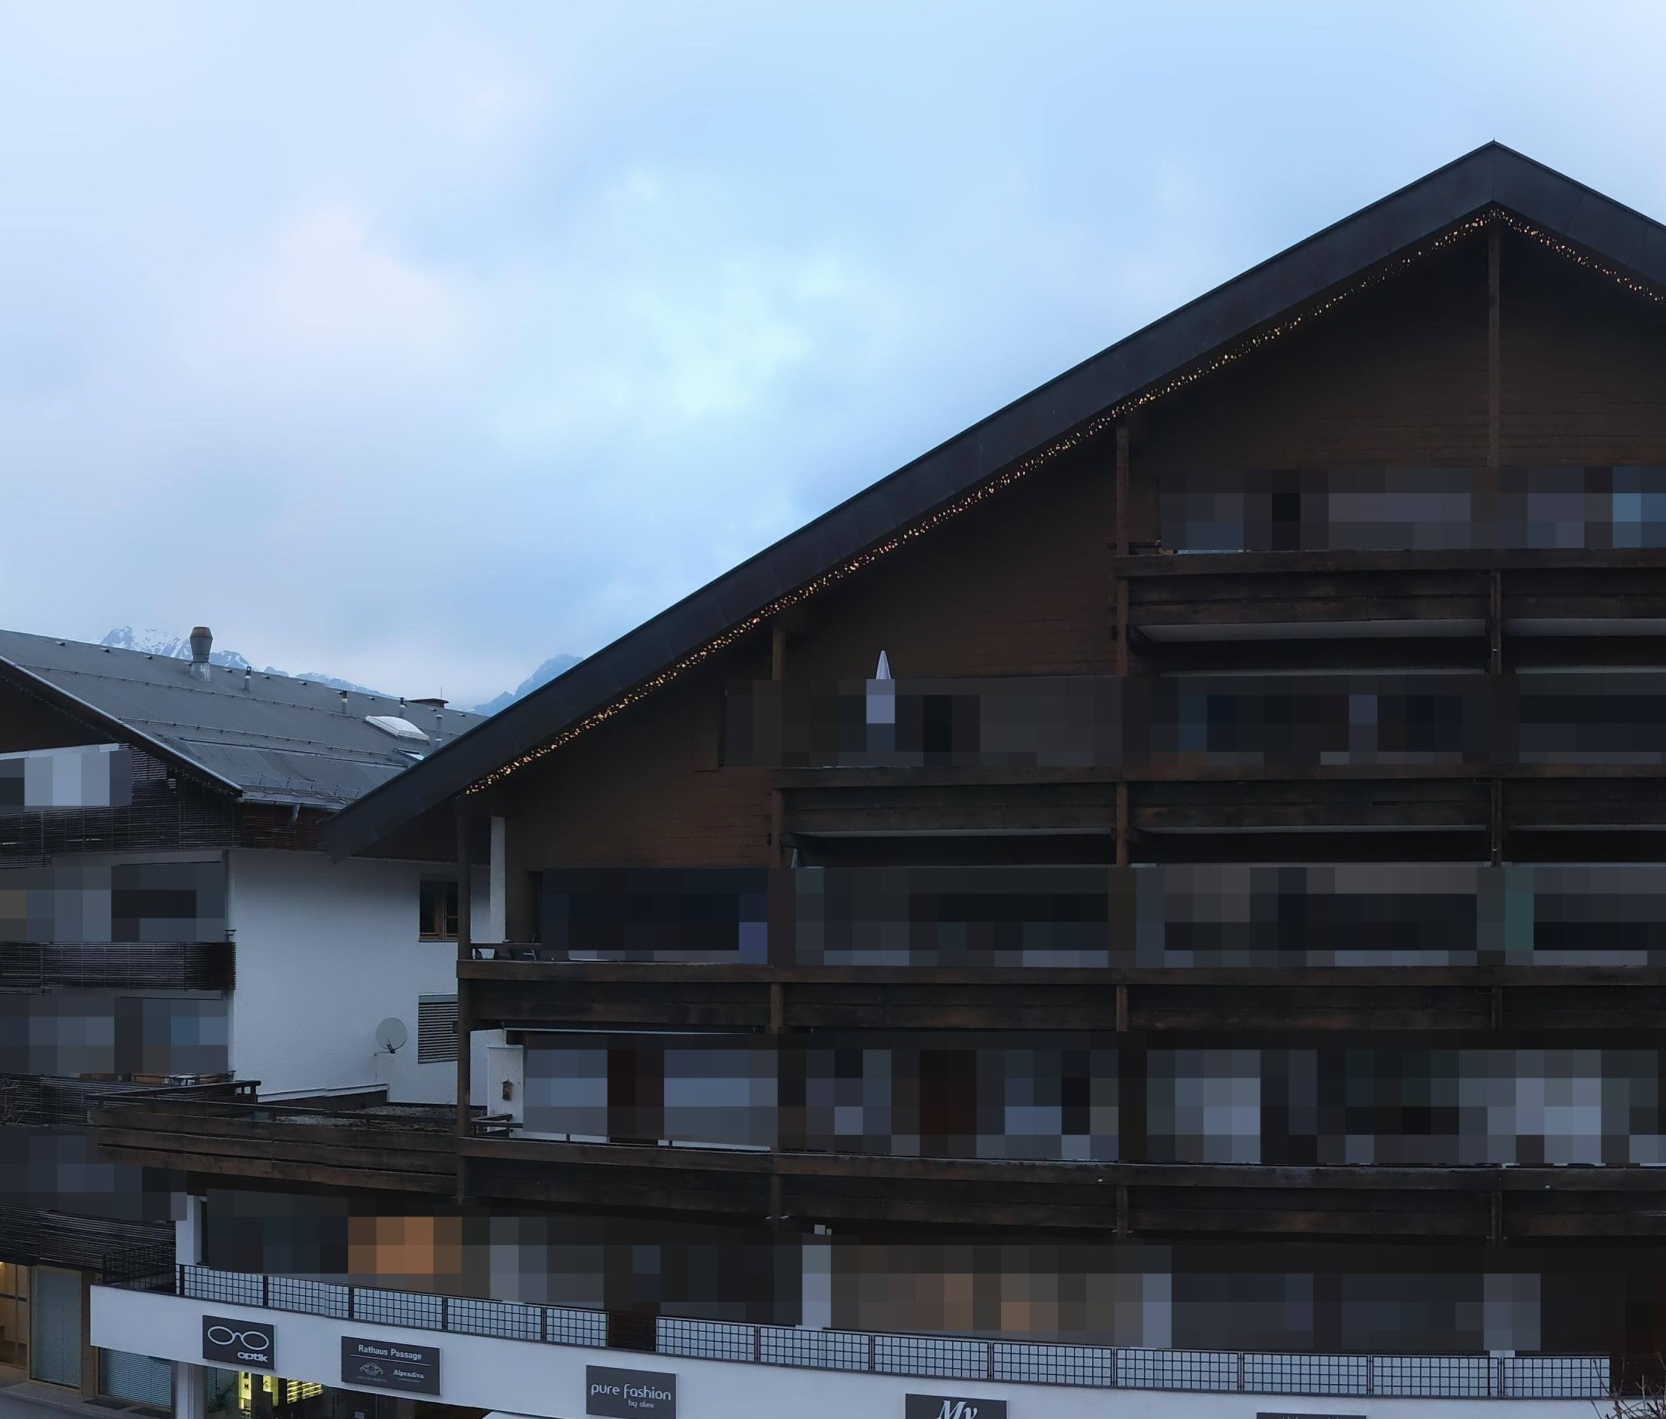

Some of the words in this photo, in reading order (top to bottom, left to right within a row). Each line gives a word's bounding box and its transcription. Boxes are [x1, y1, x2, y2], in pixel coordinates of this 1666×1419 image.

[237, 1351, 269, 1363] optik
[358, 1344, 389, 1358] Rathaus
[390, 1348, 422, 1361] Passage
[591, 1384, 620, 1396] pure
[623, 1384, 671, 1401] fashion
[628, 1399, 638, 1408] by
